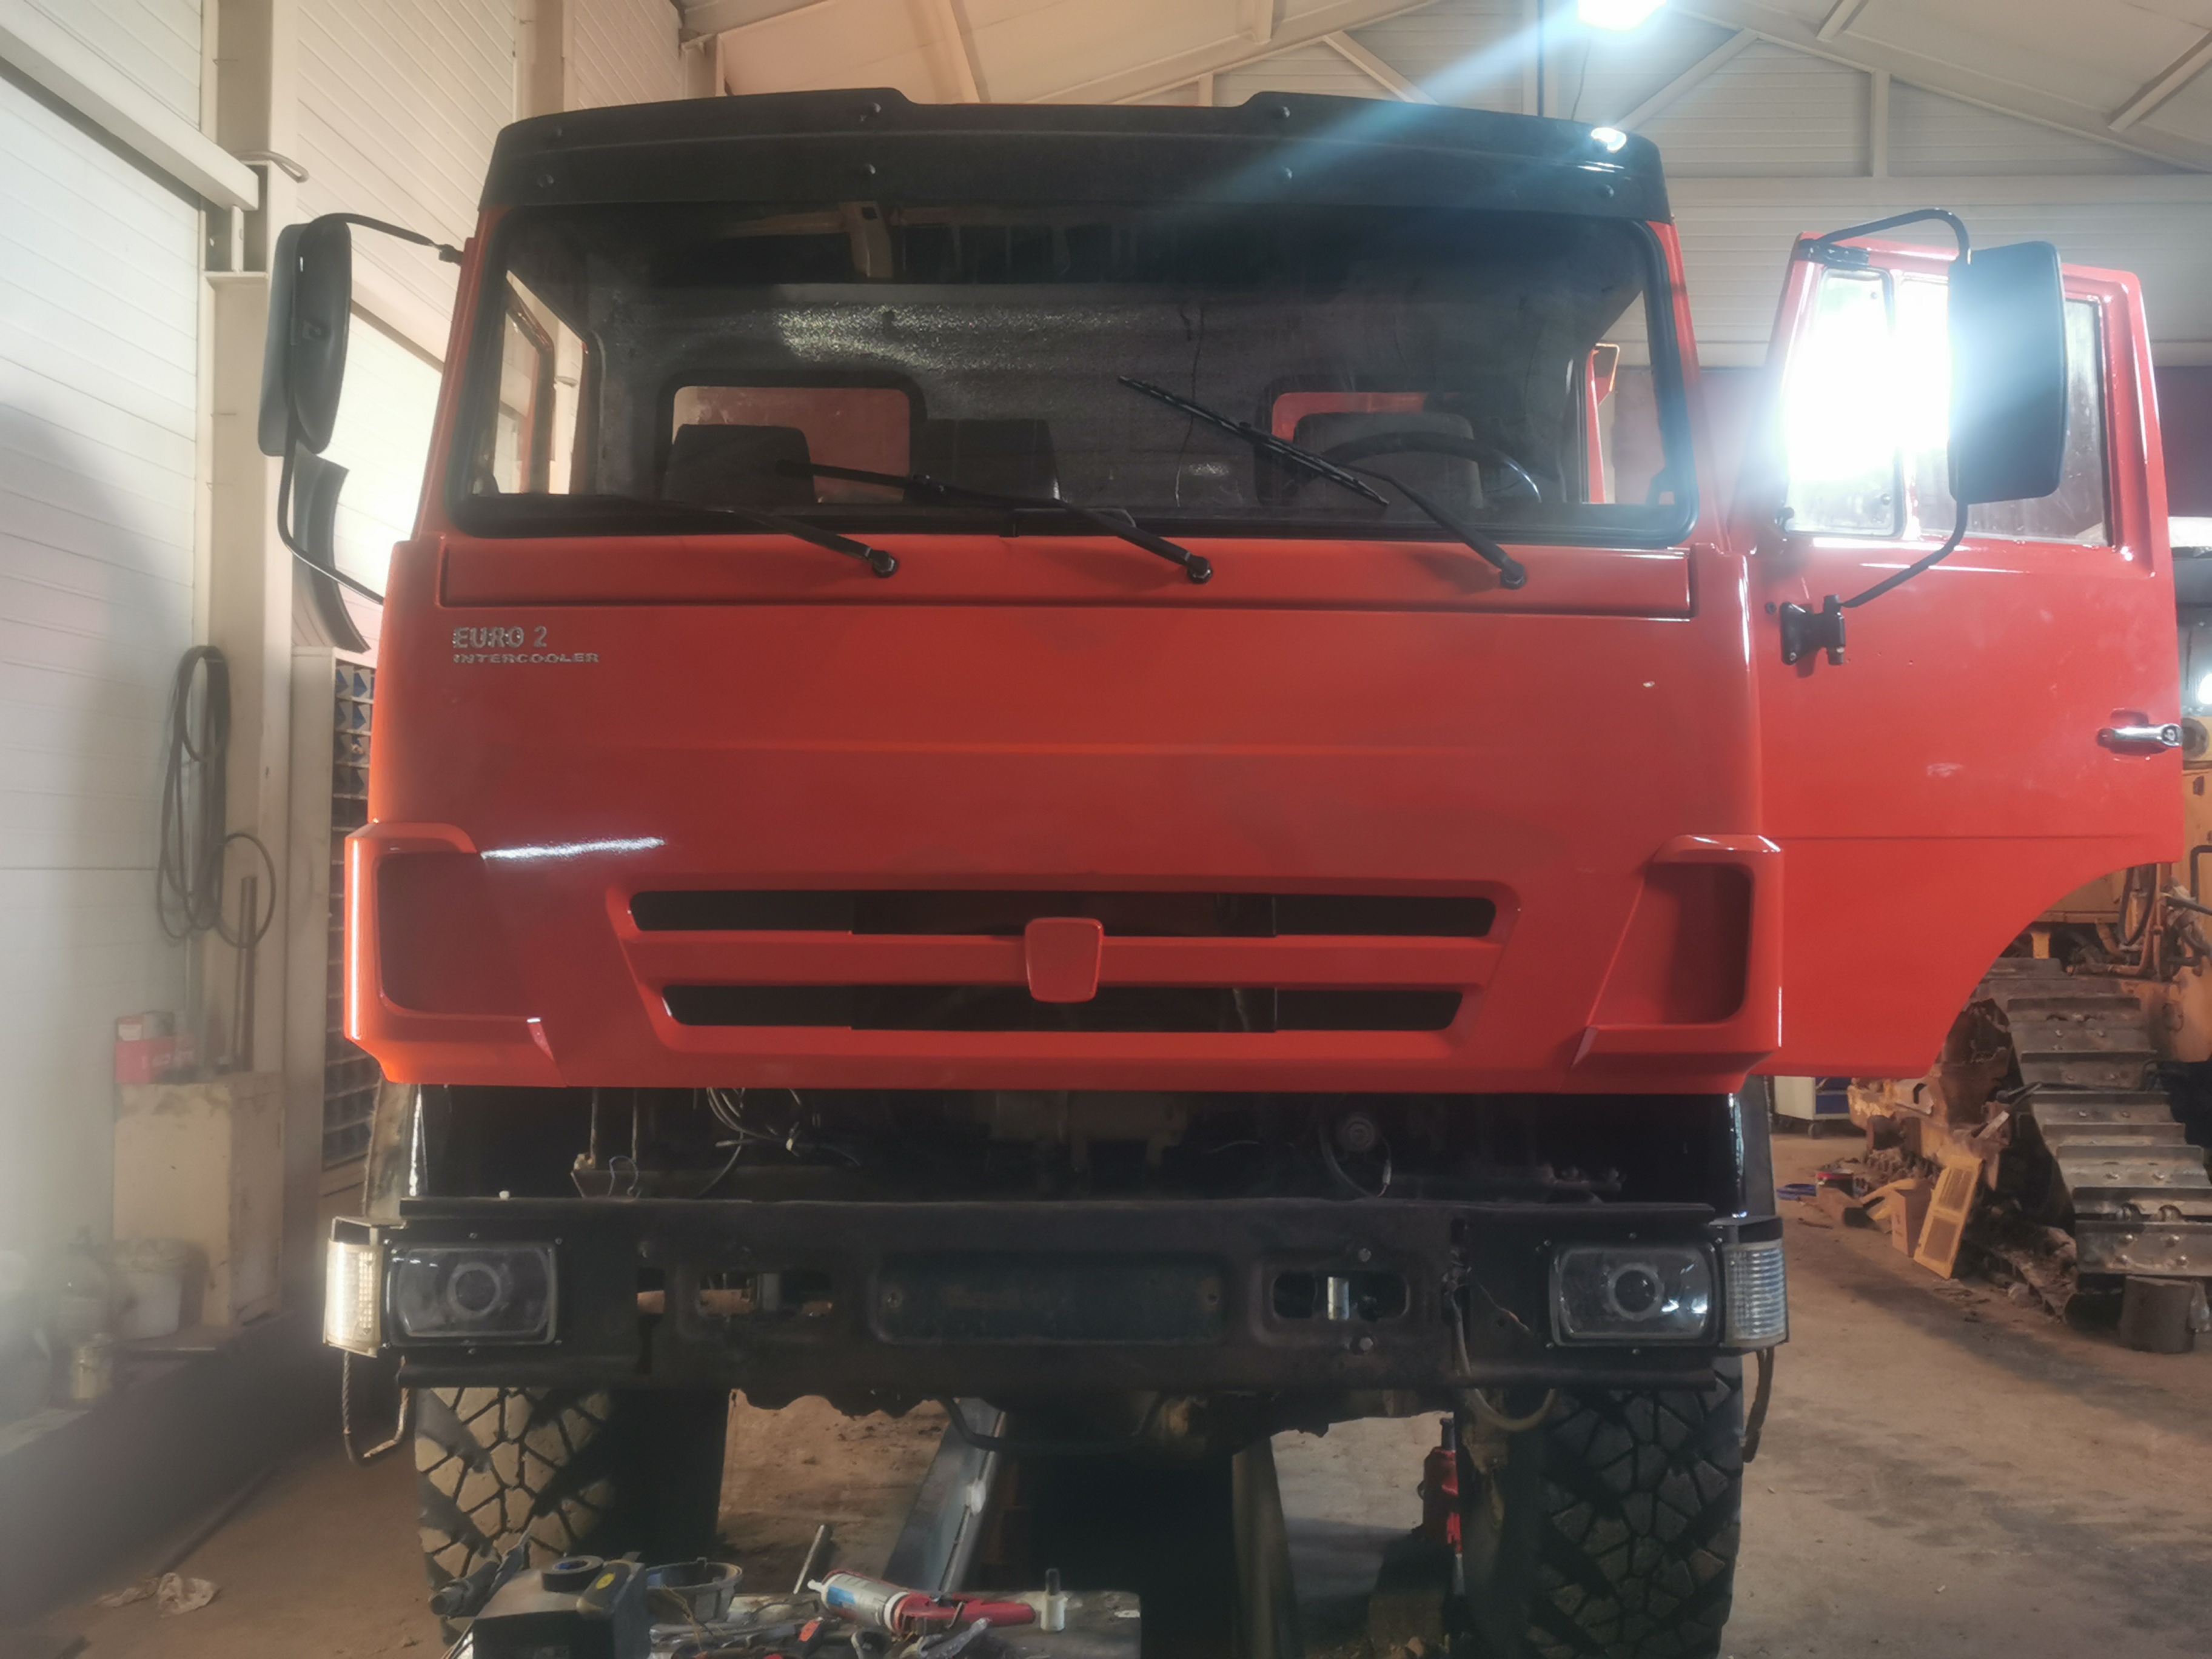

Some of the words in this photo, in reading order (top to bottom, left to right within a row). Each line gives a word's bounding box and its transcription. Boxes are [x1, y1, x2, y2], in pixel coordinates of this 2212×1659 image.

[453, 626, 525, 649] EURO
[533, 625, 548, 648] 2
[453, 652, 599, 664] INTERCOOLER
